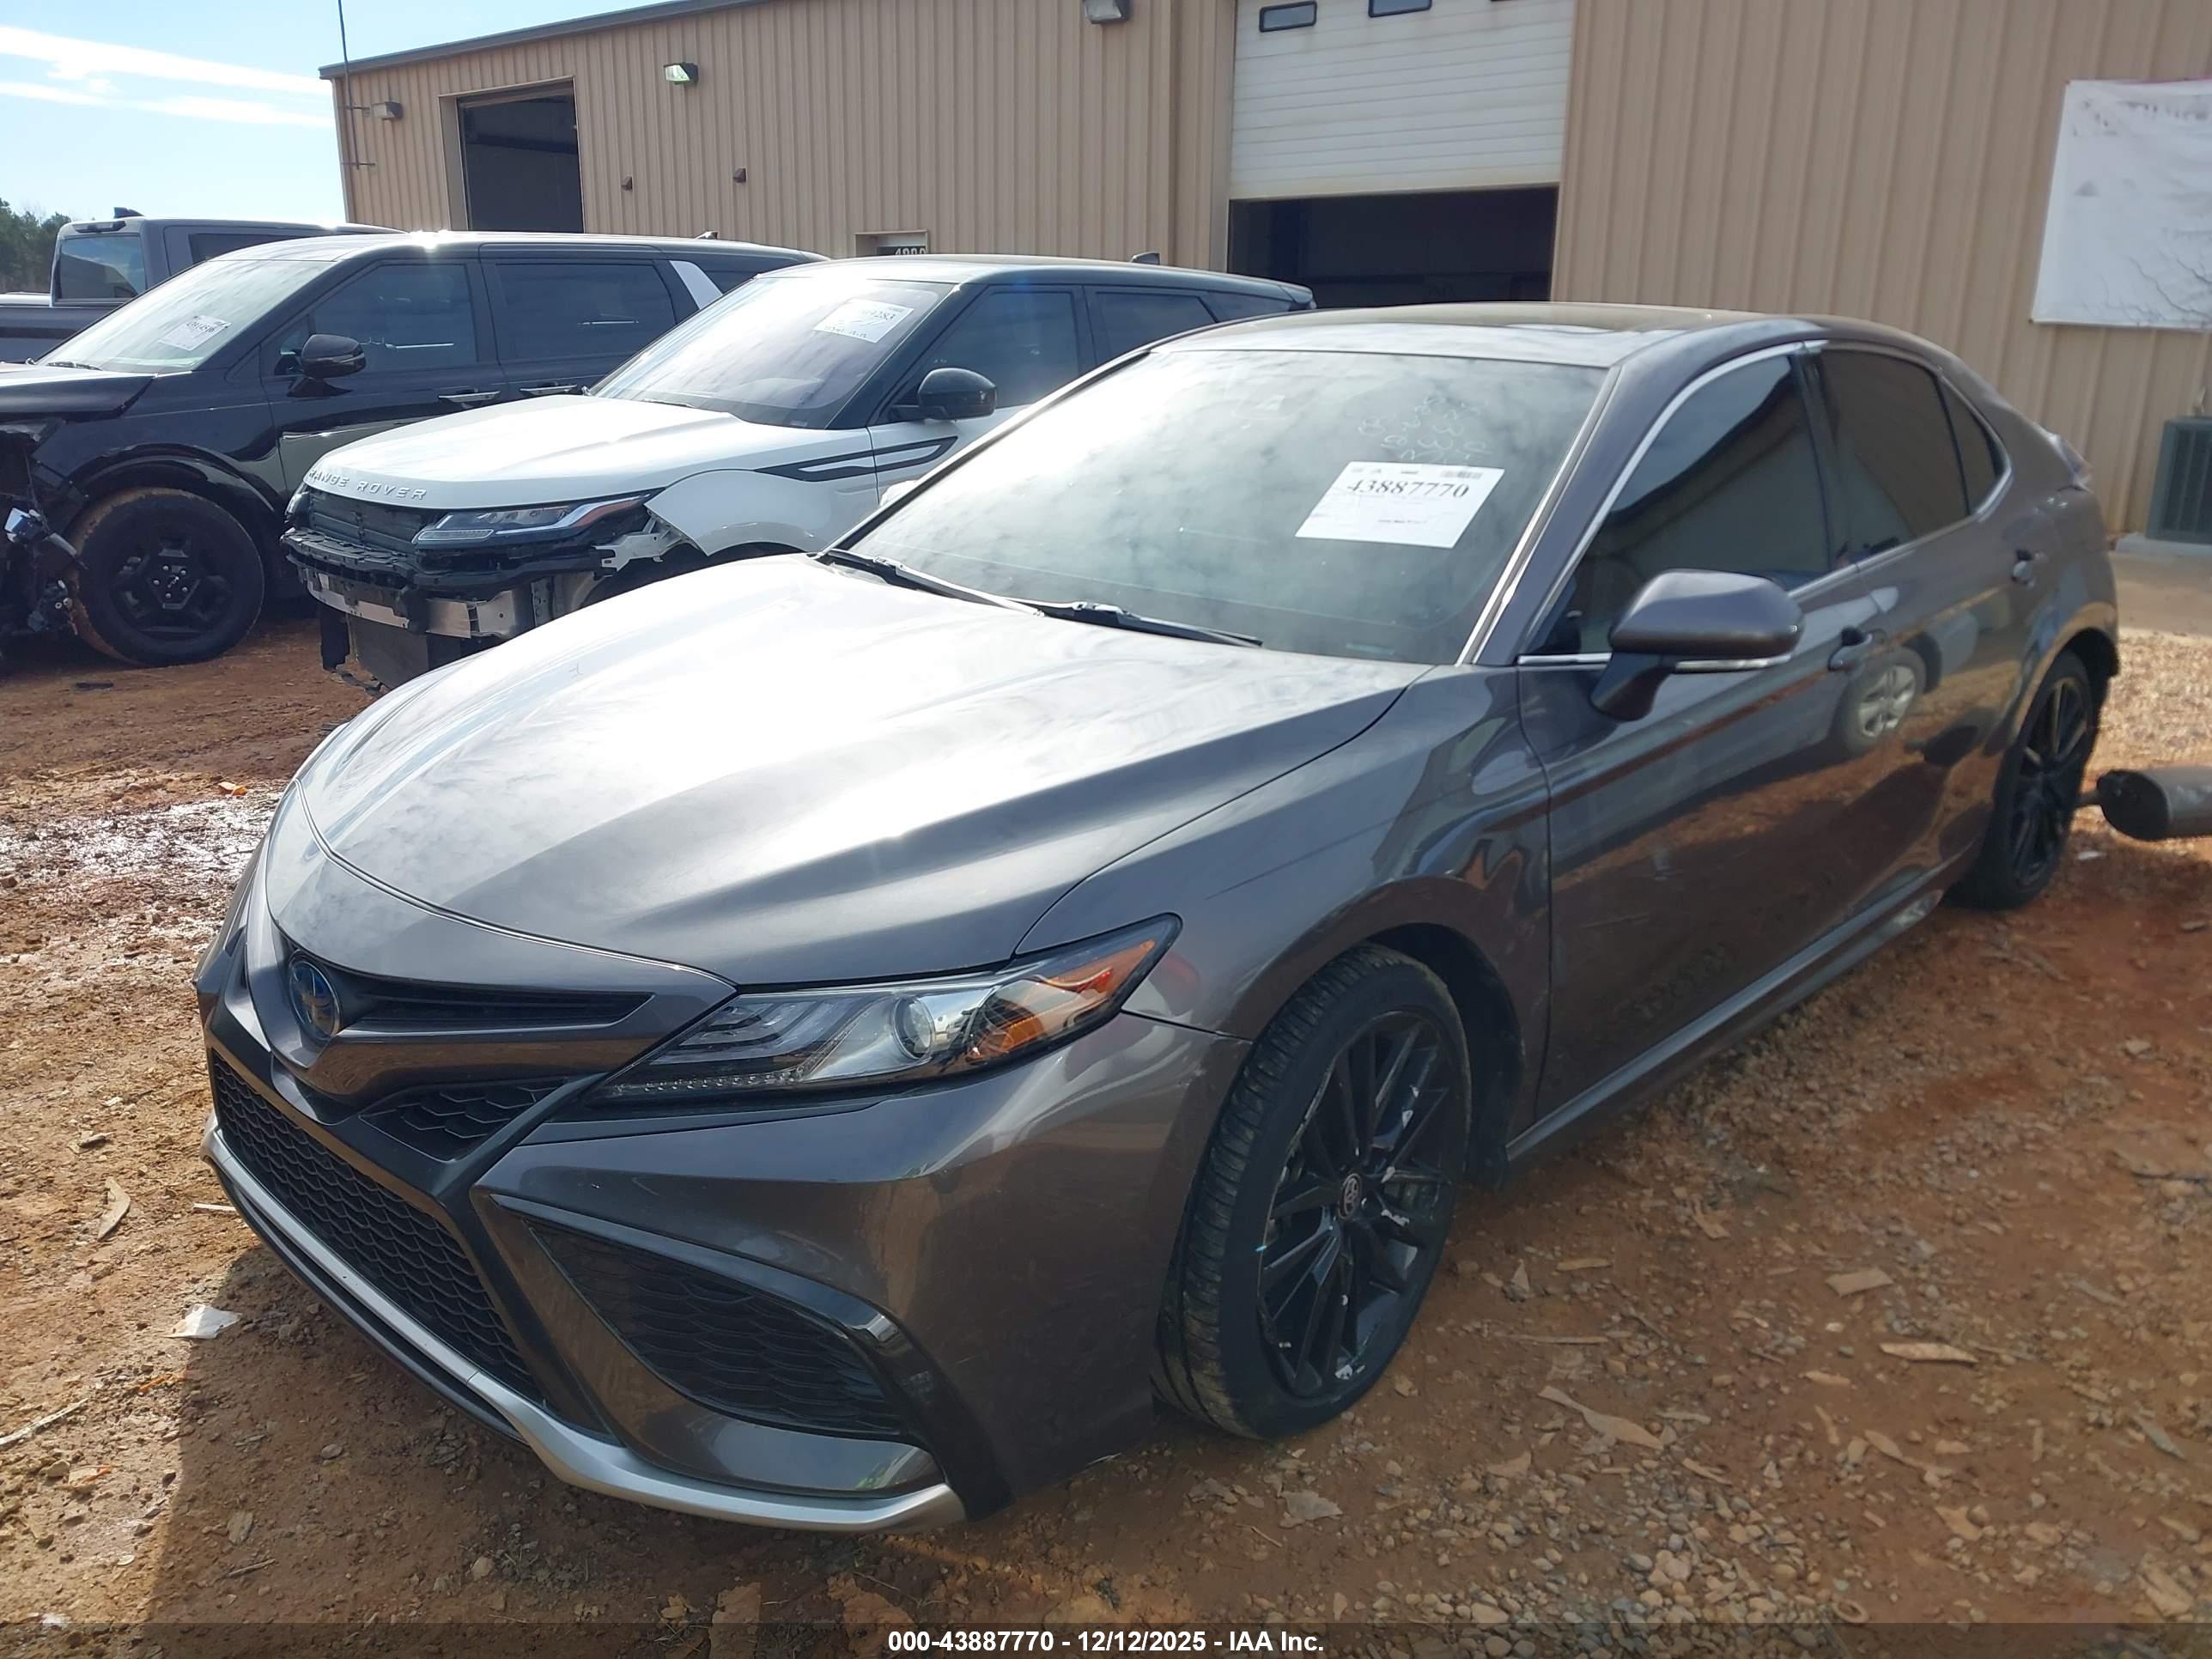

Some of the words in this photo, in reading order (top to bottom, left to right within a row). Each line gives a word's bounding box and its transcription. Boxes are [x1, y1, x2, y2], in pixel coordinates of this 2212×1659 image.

[309, 470, 350, 488] RANGE
[356, 480, 428, 501] ROVER
[1346, 478, 1470, 499] 43887770
